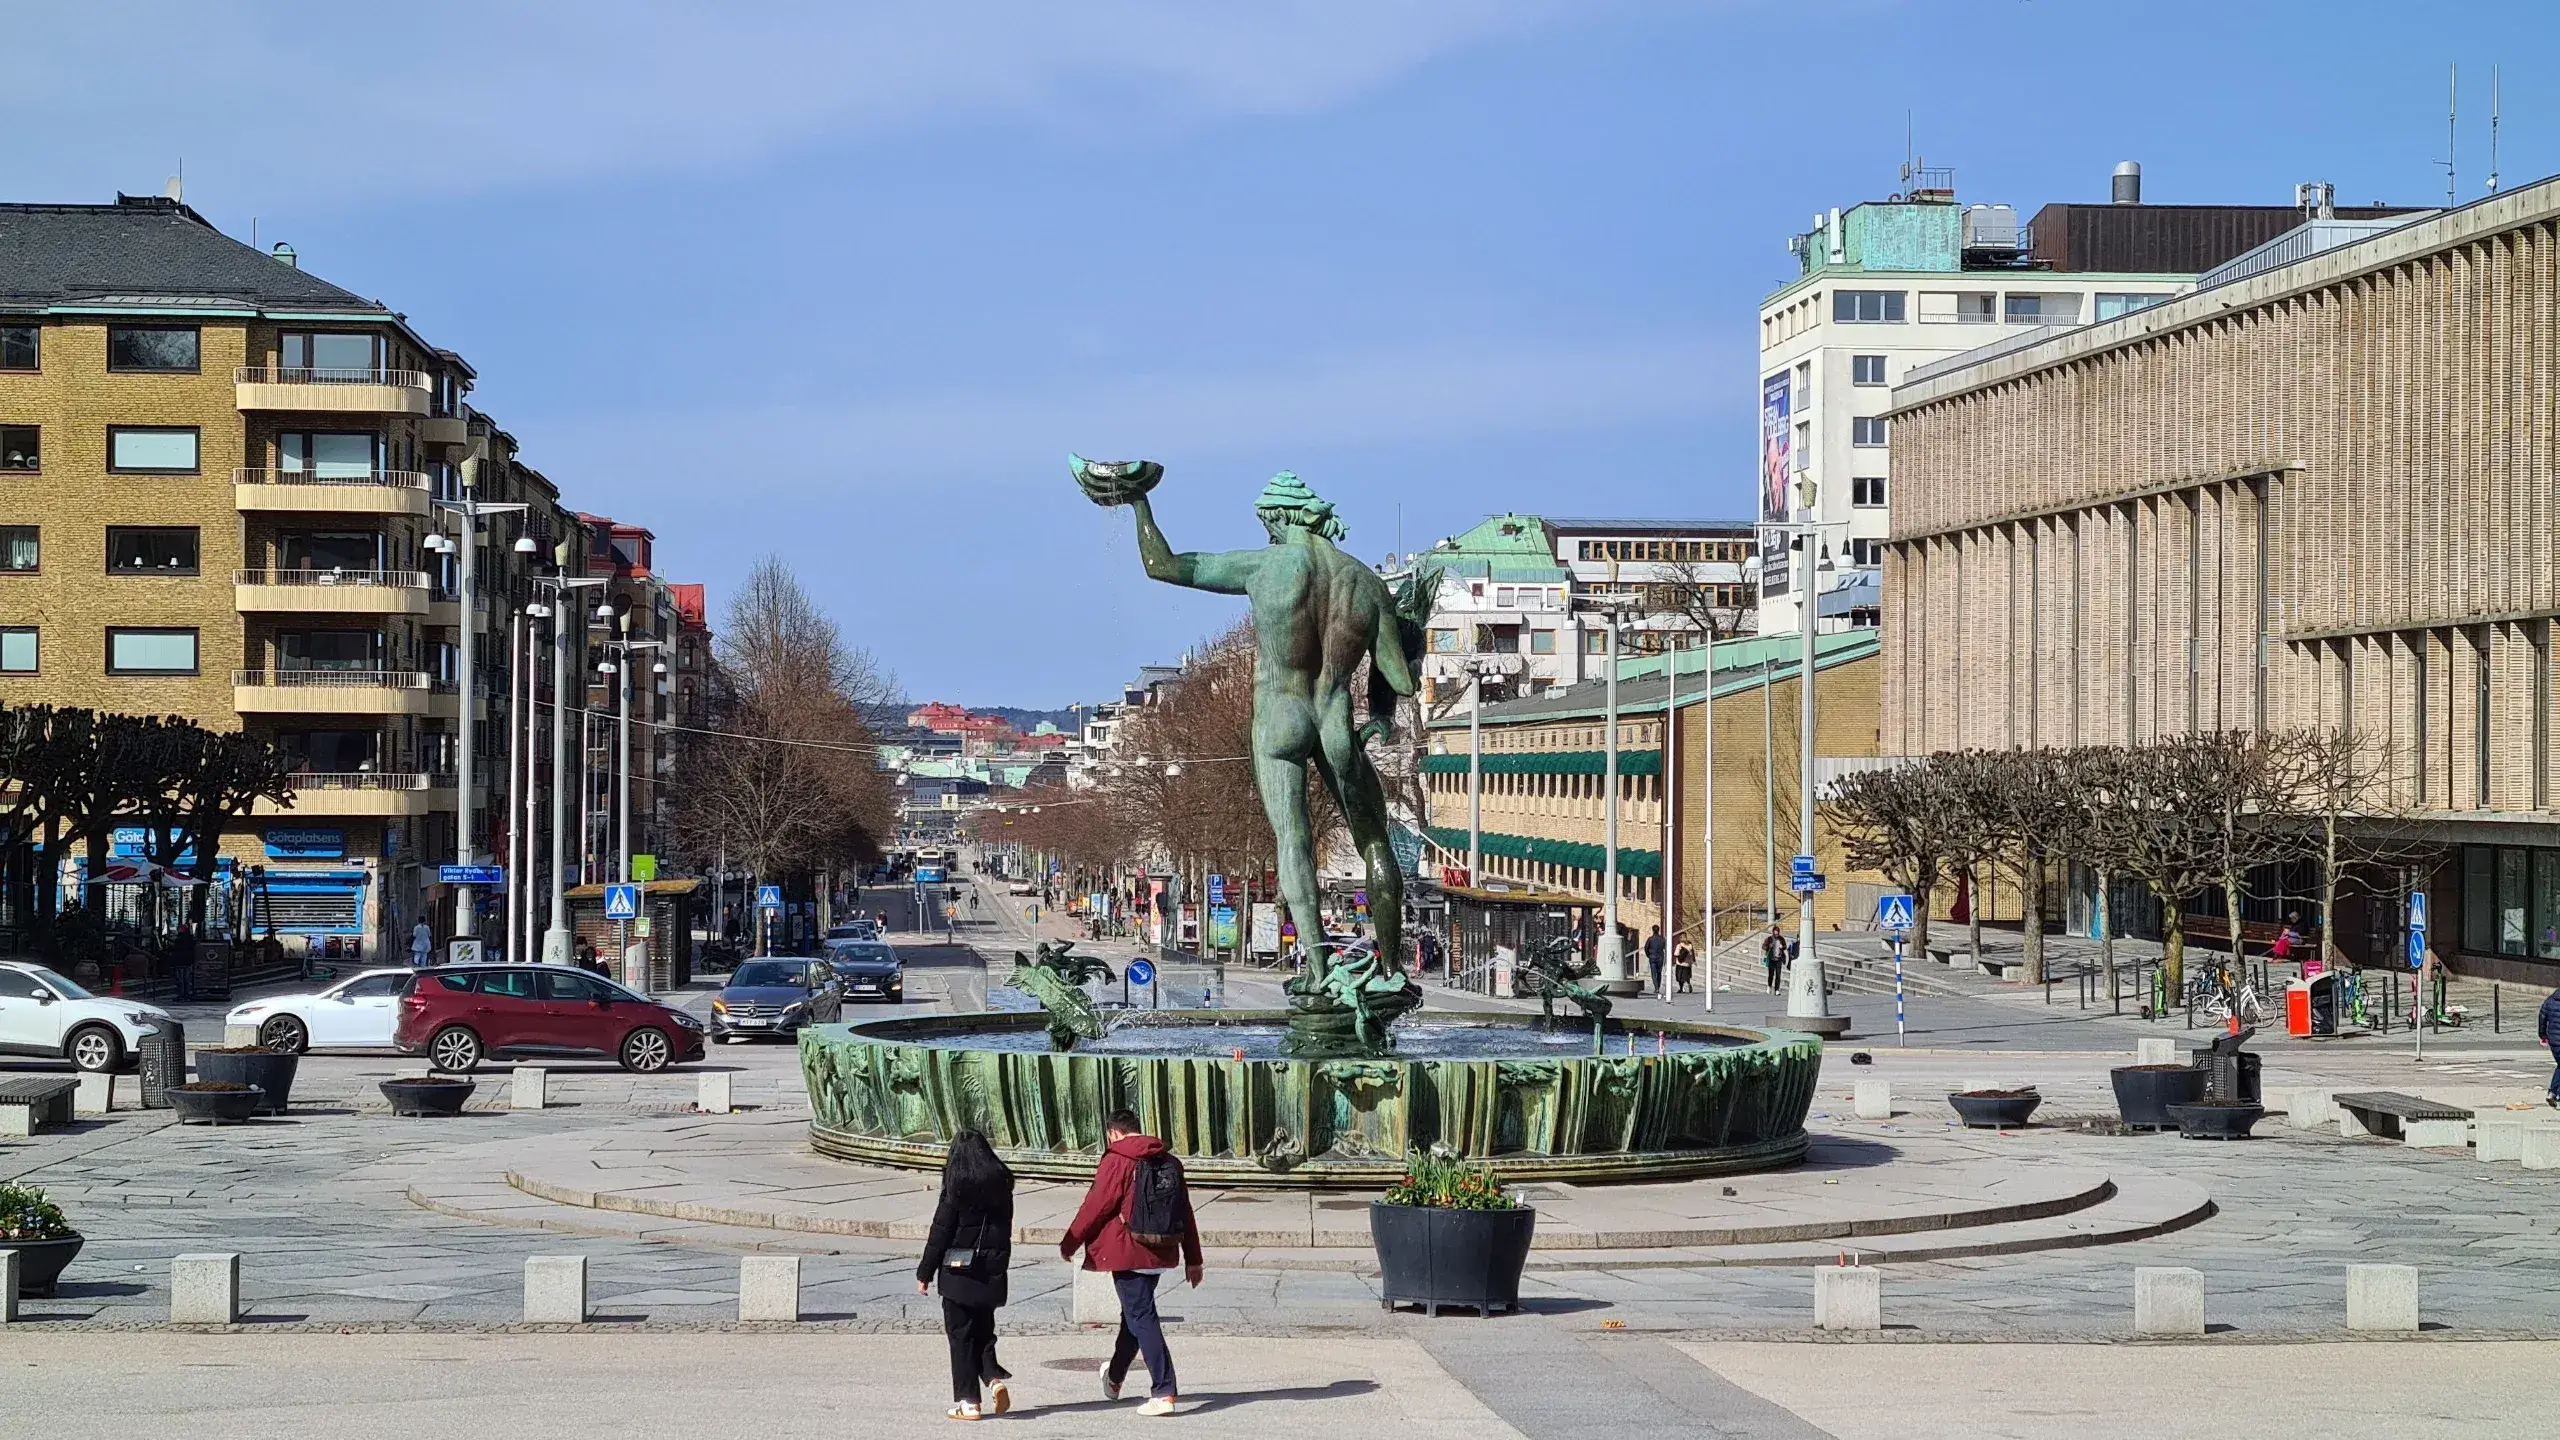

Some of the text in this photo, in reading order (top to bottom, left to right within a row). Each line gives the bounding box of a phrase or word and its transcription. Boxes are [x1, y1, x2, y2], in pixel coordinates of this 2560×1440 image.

[266, 831, 341, 845] Götaplatsens
[640, 870, 646, 878] 6
[1213, 875, 1220, 886] P
